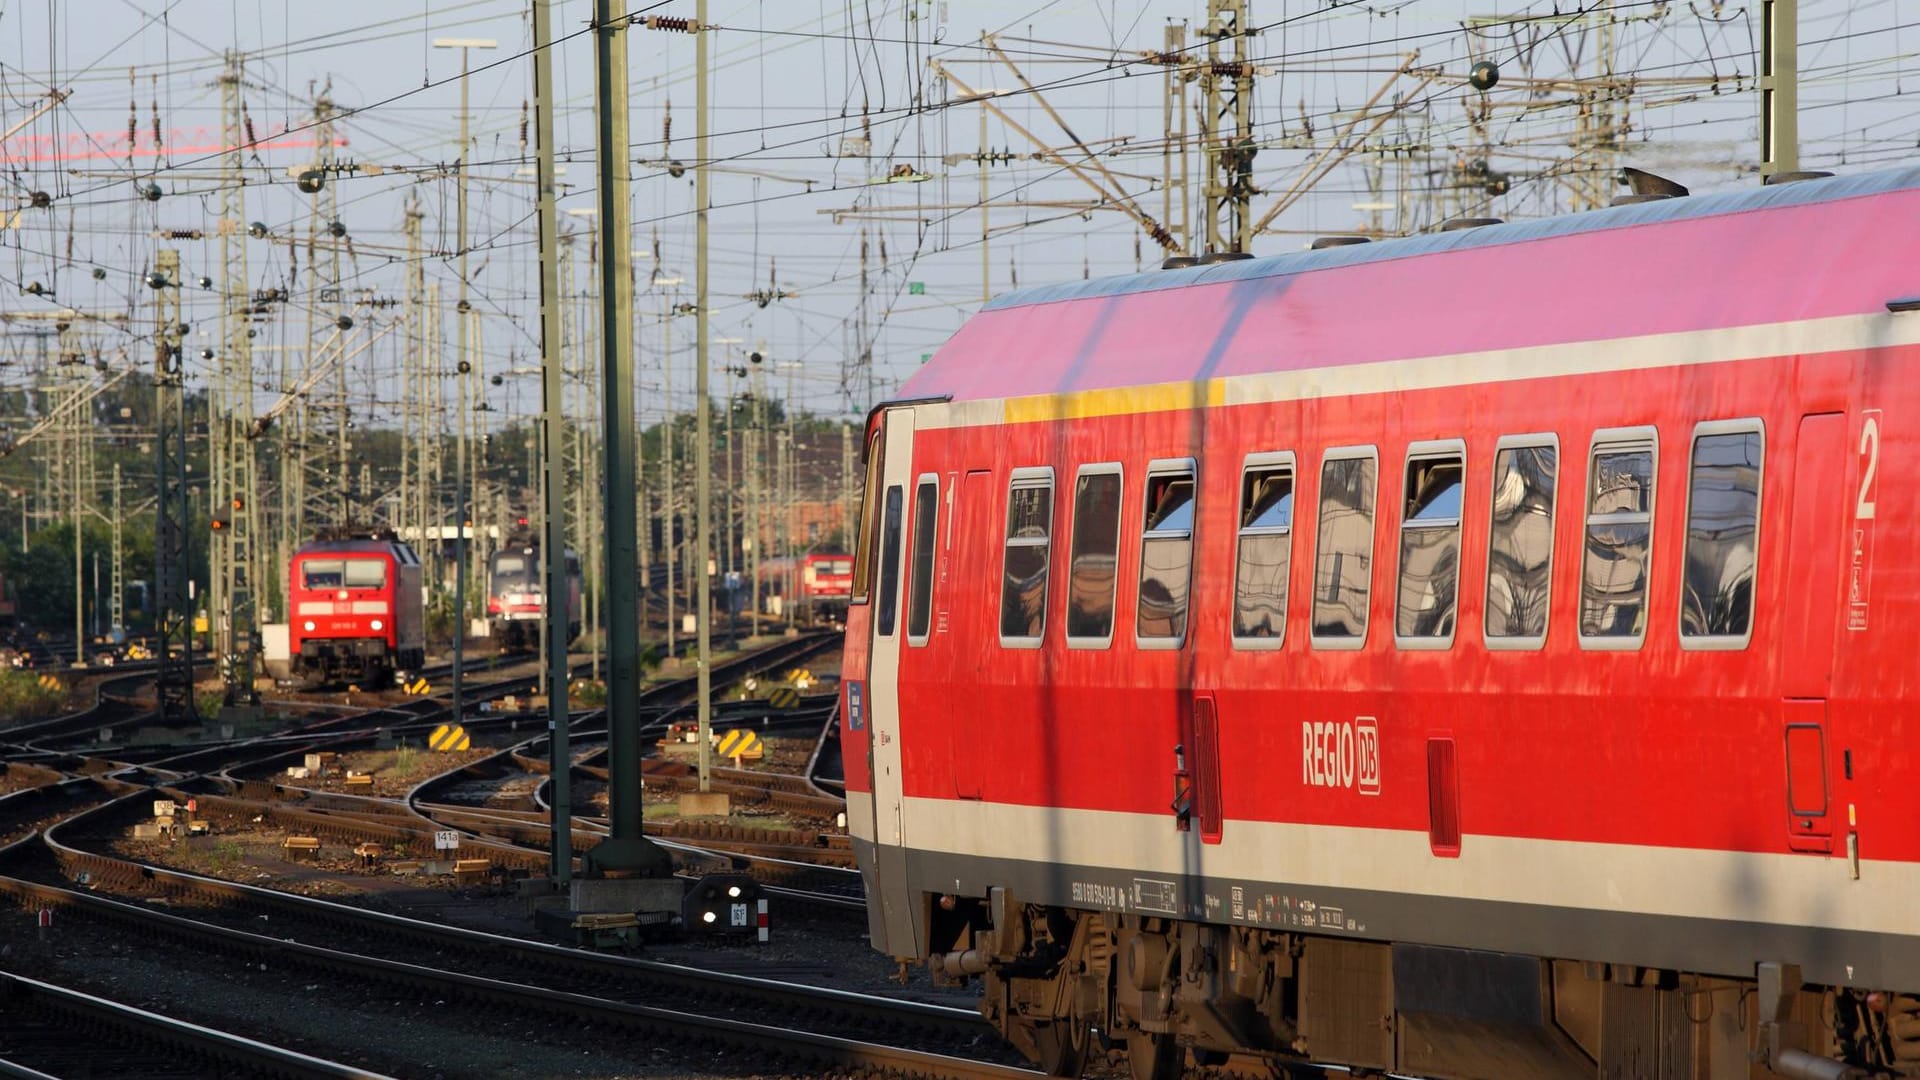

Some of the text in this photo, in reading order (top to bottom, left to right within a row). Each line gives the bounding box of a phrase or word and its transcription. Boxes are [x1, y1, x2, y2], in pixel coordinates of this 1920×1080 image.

[1856, 418, 1879, 519] 2
[1303, 721, 1379, 790] REGIO DB
[437, 832, 458, 842] 141a
